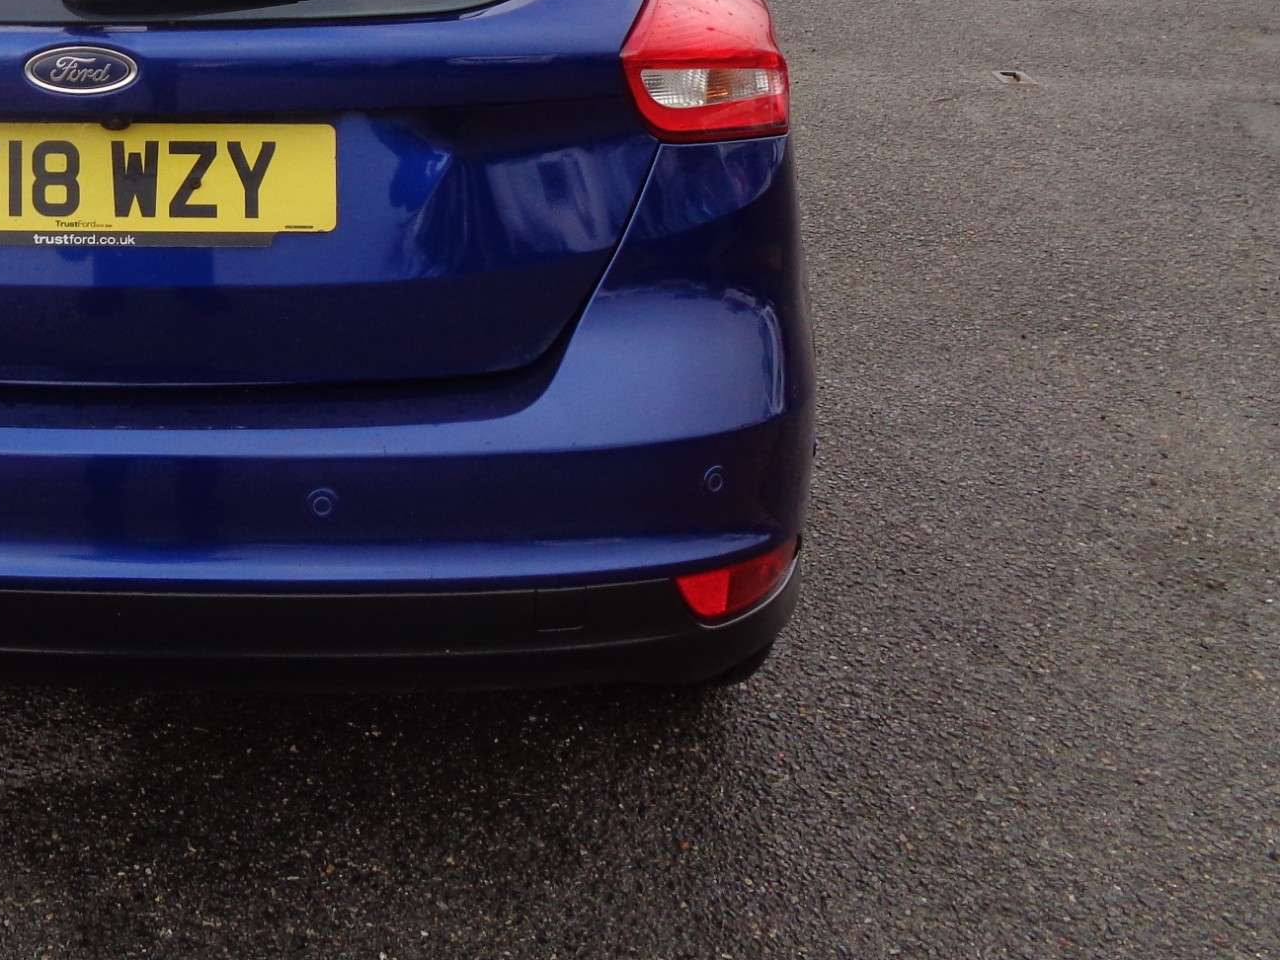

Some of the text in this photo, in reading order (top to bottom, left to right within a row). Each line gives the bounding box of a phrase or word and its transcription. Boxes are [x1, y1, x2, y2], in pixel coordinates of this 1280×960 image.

[50, 56, 111, 82] Ford
[111, 140, 277, 219] WZY
[55, 220, 96, 228] TrustFord
[33, 233, 136, 245] trustford.co.uk
